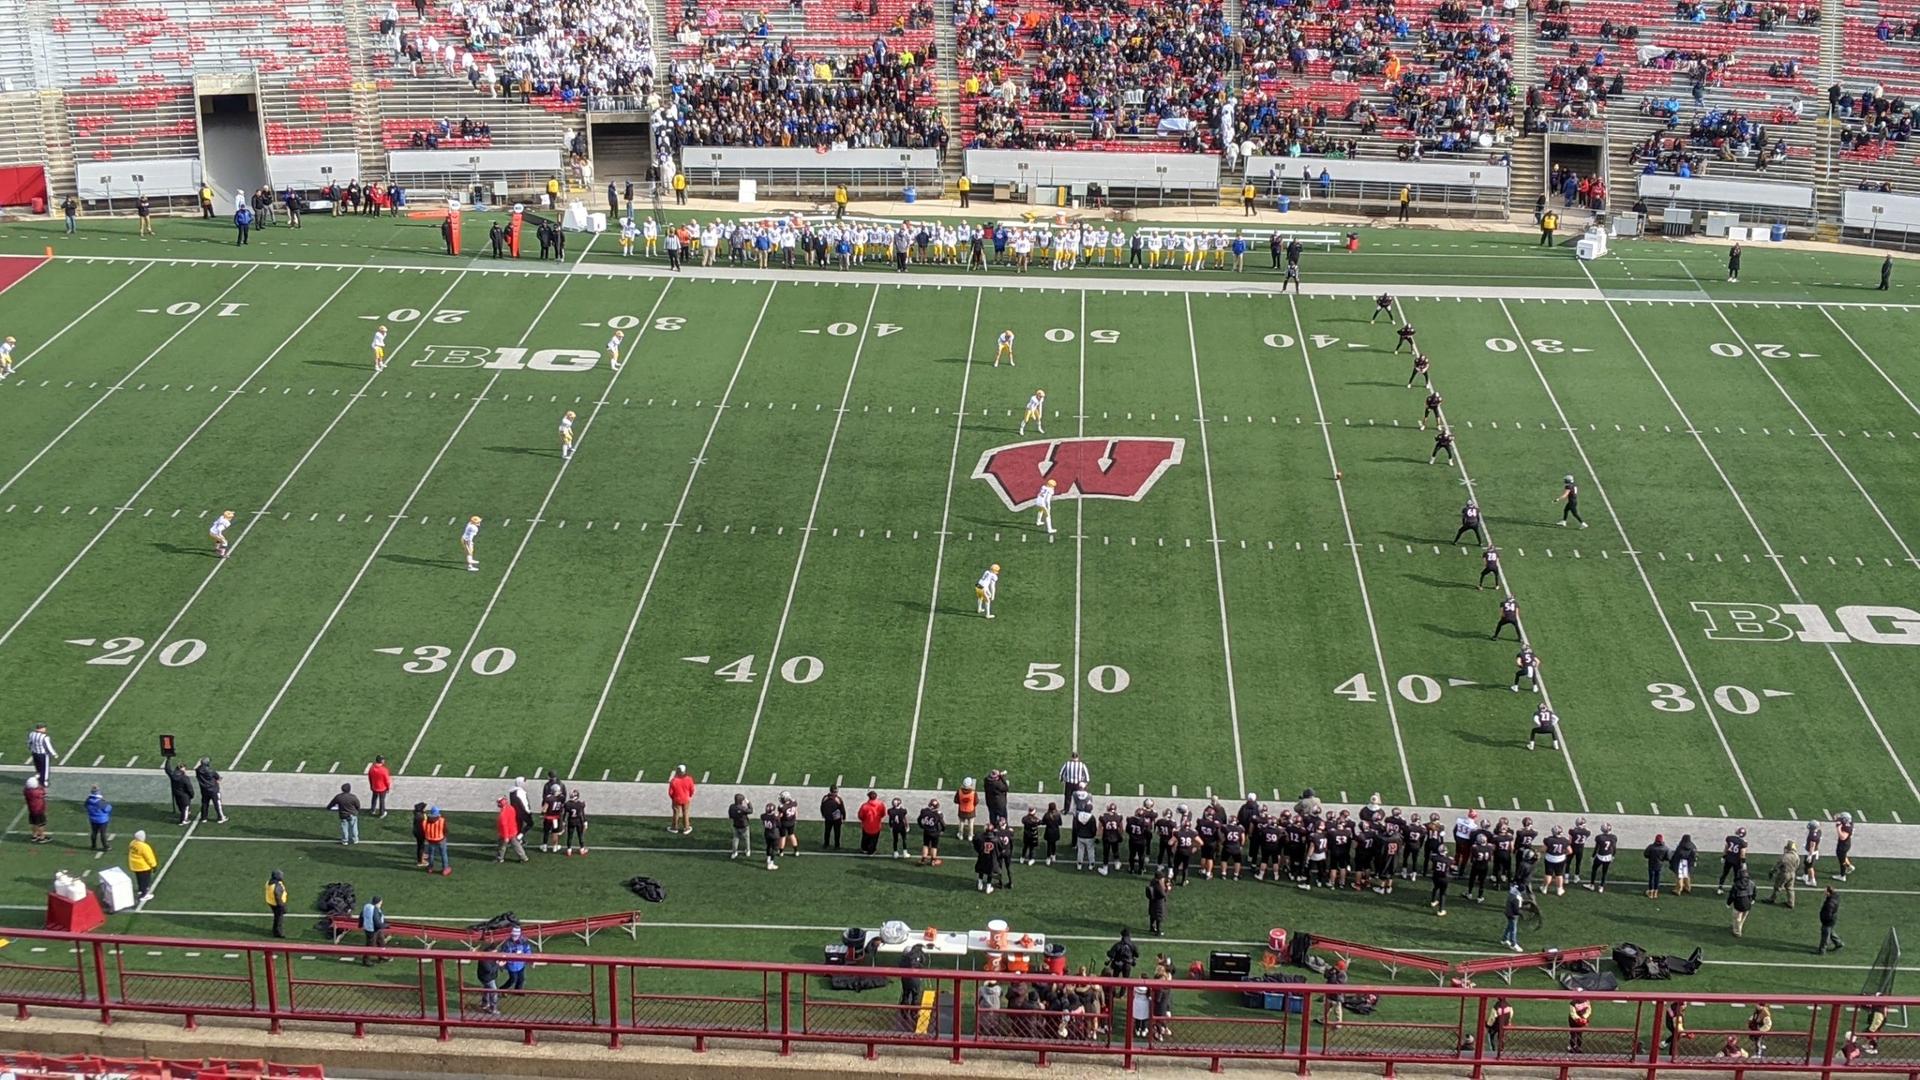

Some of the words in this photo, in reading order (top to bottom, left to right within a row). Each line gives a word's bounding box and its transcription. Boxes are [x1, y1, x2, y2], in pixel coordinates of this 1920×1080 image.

[87, 637, 207, 667] 20
[403, 646, 517, 676] 30
[715, 655, 824, 684] 40
[1024, 663, 1130, 692] 50
[1334, 673, 1442, 704] 40
[1647, 683, 1760, 715] 30
[1603, 840, 1611, 851] 7
